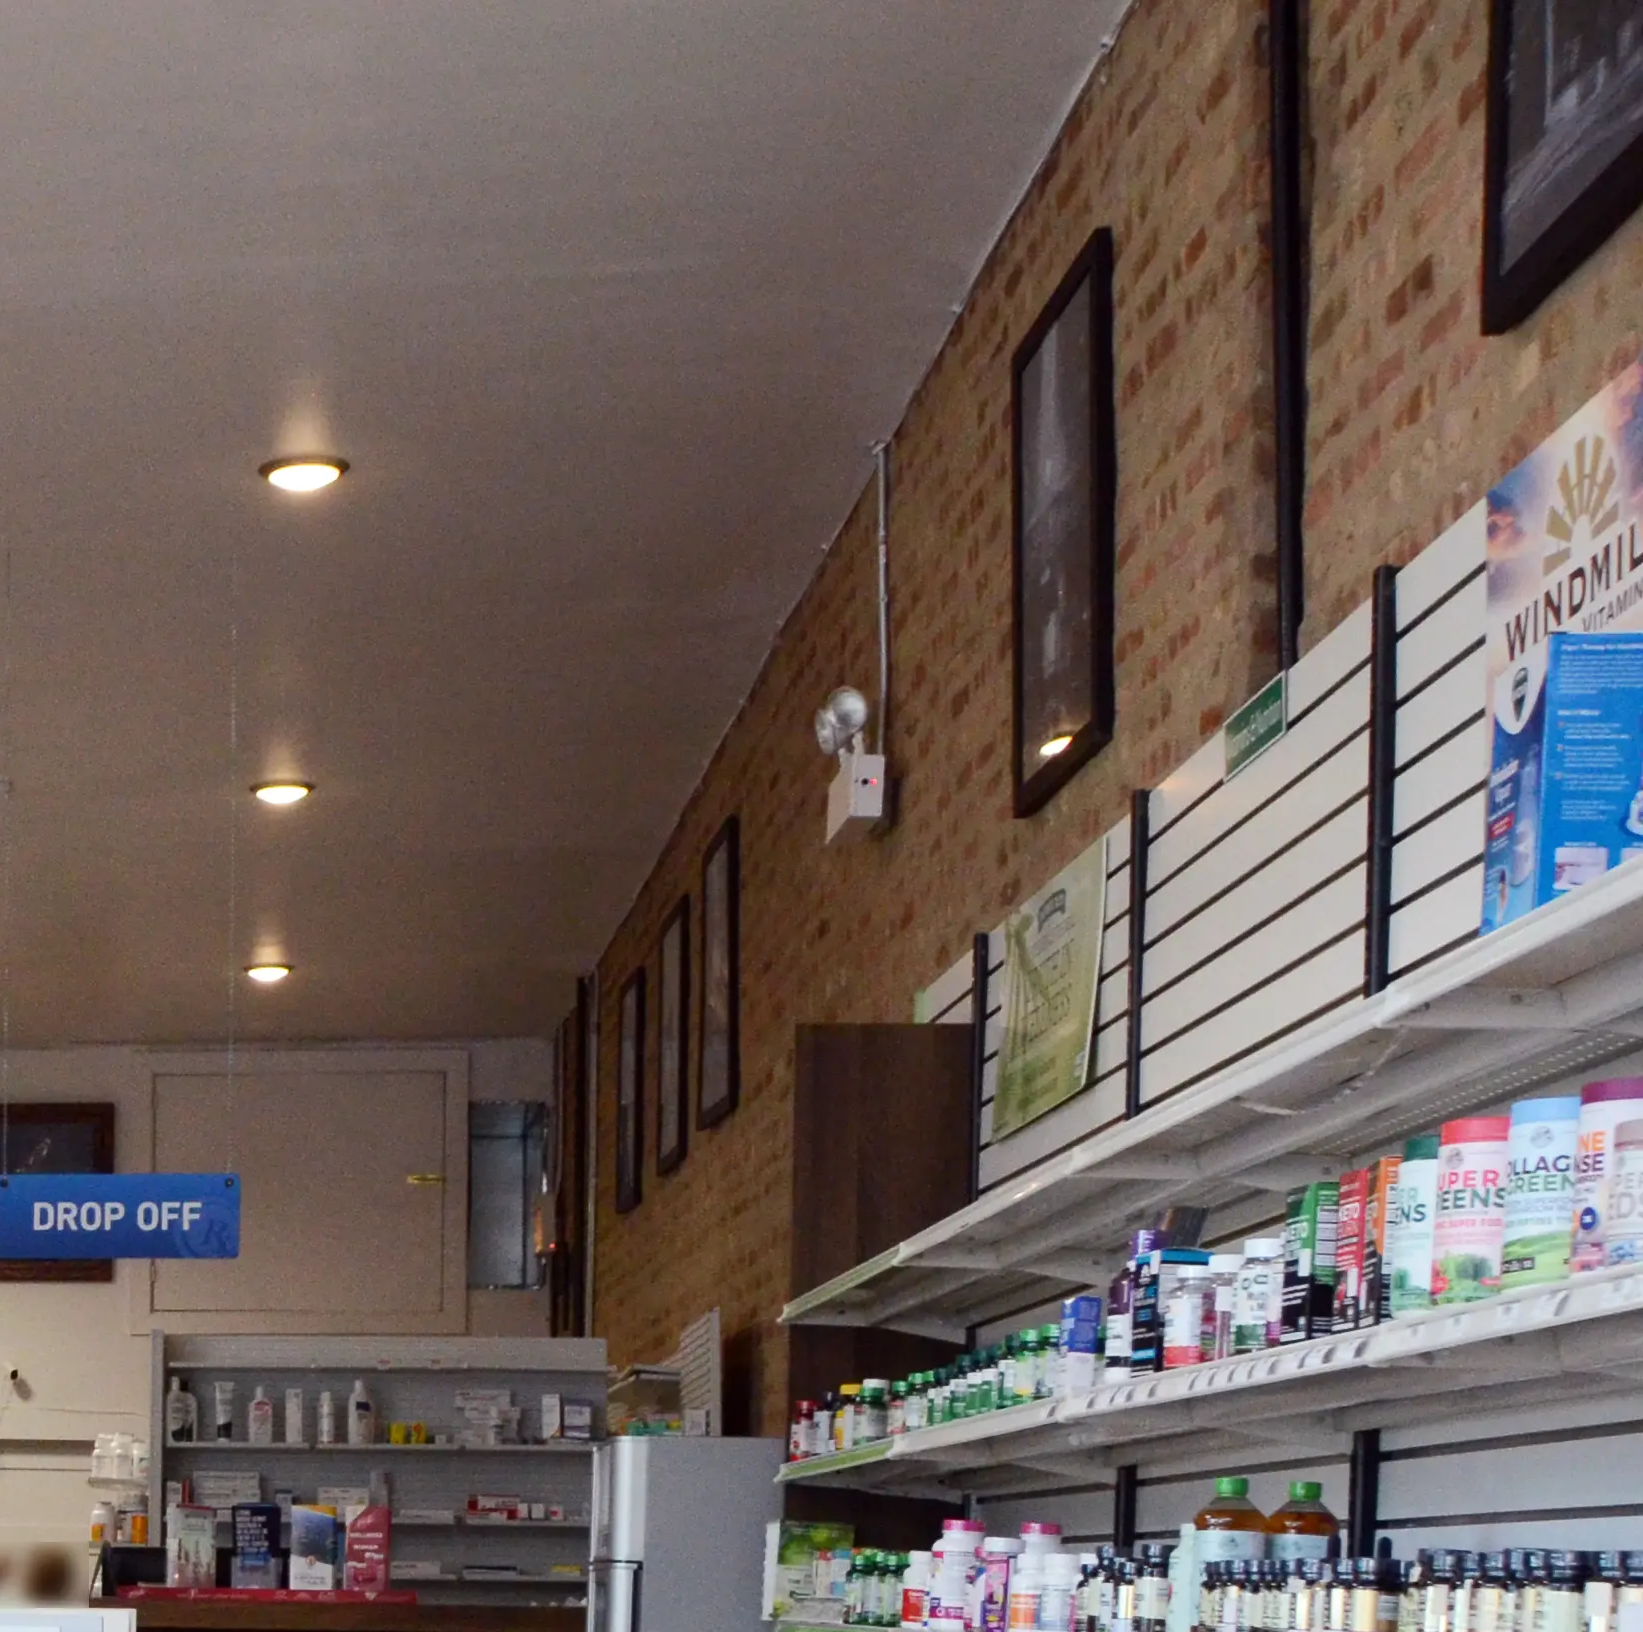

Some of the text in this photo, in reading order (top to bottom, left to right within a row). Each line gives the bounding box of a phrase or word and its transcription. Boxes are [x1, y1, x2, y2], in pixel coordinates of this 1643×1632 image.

[1506, 522, 1643, 662] WINDMIL
[33, 1202, 202, 1231] DROP OFF
